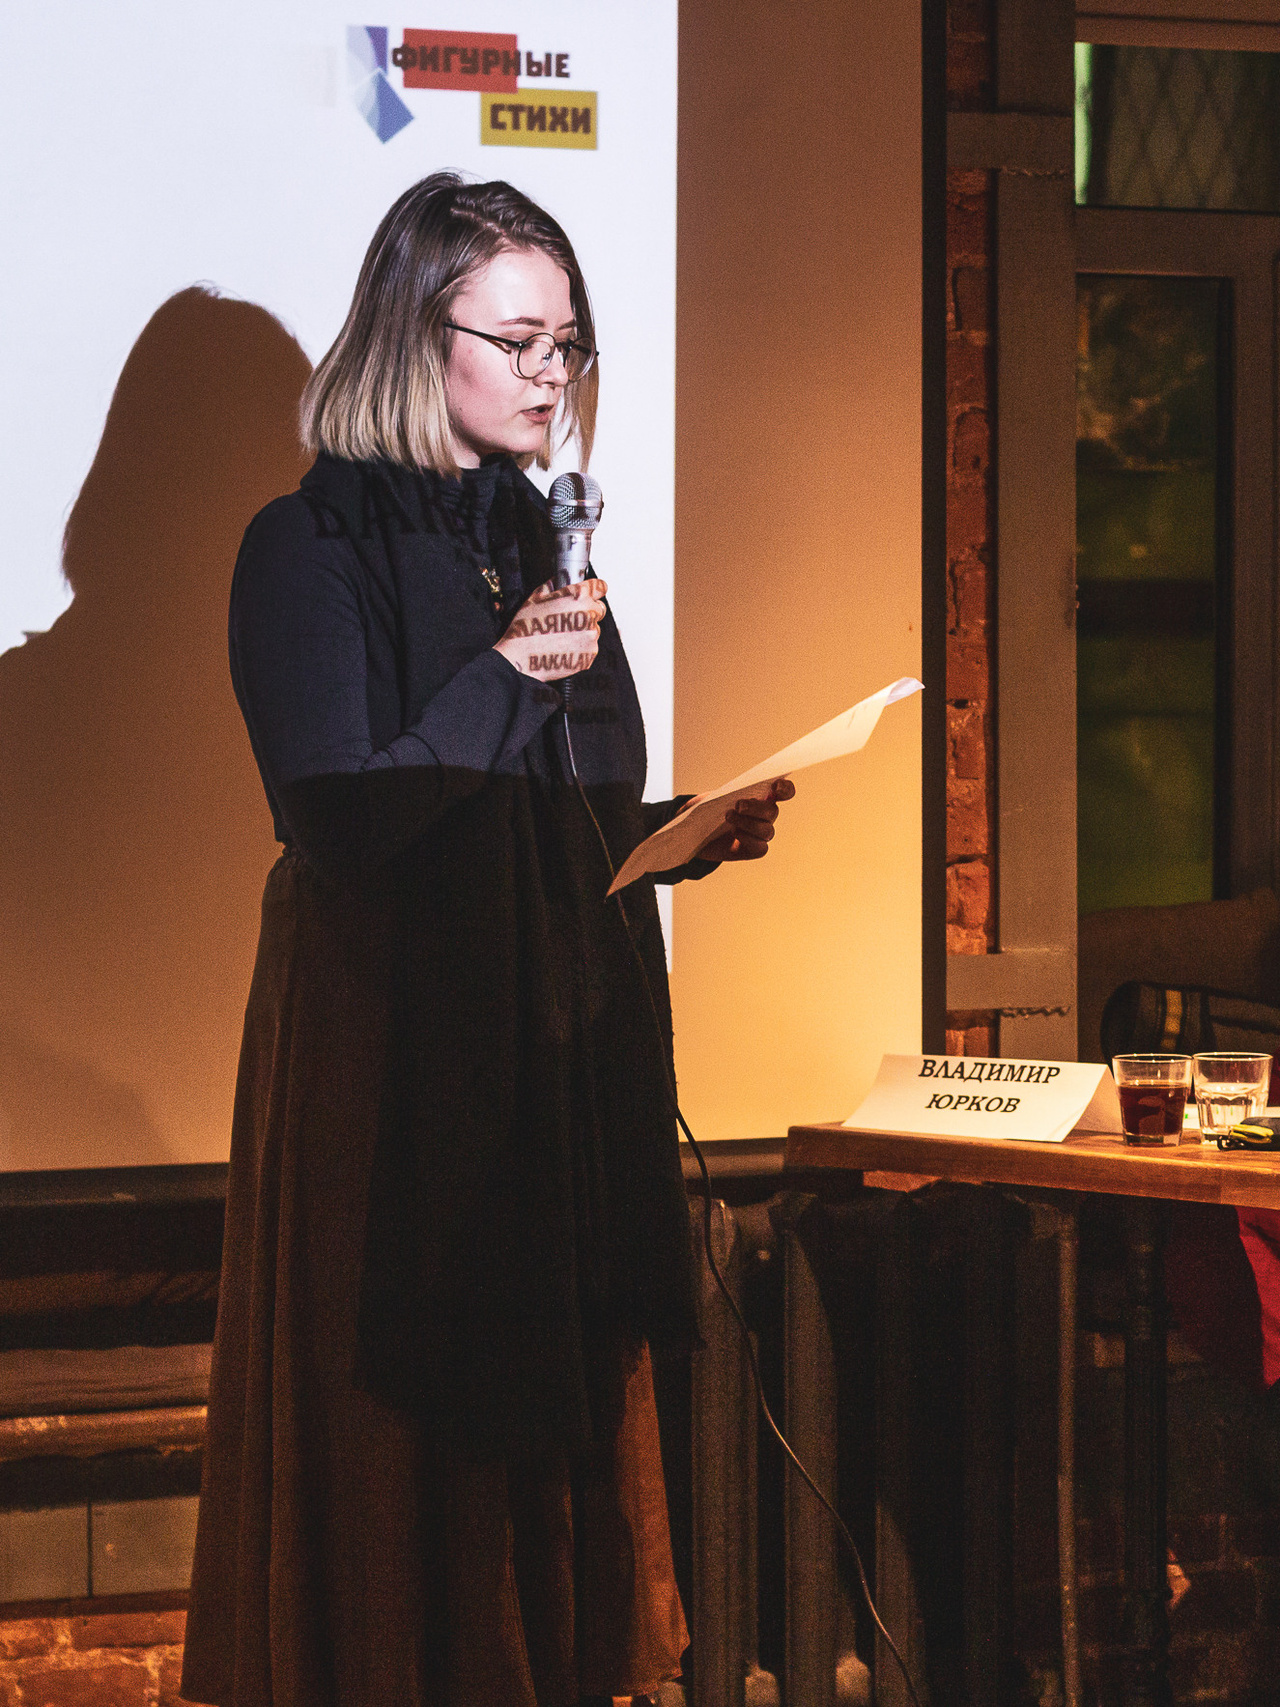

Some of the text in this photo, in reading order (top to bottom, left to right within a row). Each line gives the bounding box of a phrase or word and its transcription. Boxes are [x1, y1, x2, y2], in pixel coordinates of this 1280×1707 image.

[391, 44, 571, 78] ФИГУРНЫЕ
[489, 103, 592, 135] СТИХИ
[918, 1058, 1061, 1084] ВЛАДИМИР
[924, 1093, 1021, 1113] ЮРКОВ
